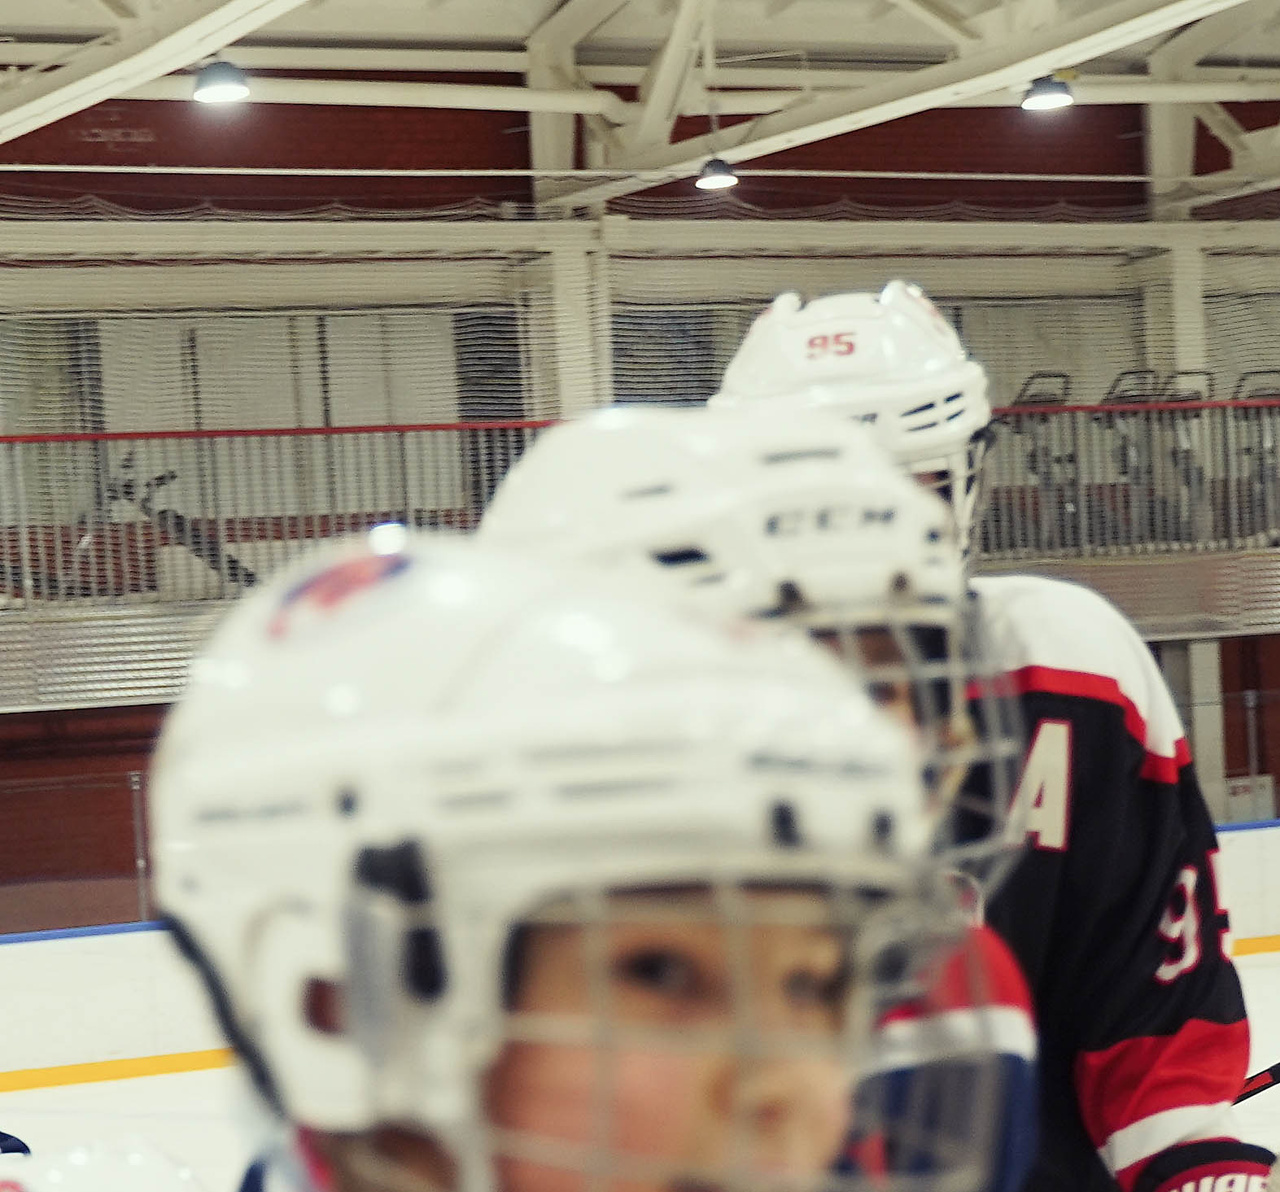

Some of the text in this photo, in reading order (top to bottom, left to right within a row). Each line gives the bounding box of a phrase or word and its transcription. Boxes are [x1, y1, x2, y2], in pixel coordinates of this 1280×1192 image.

[807, 332, 857, 360] 95
[763, 505, 898, 539] CCM
[1003, 718, 1072, 852] A
